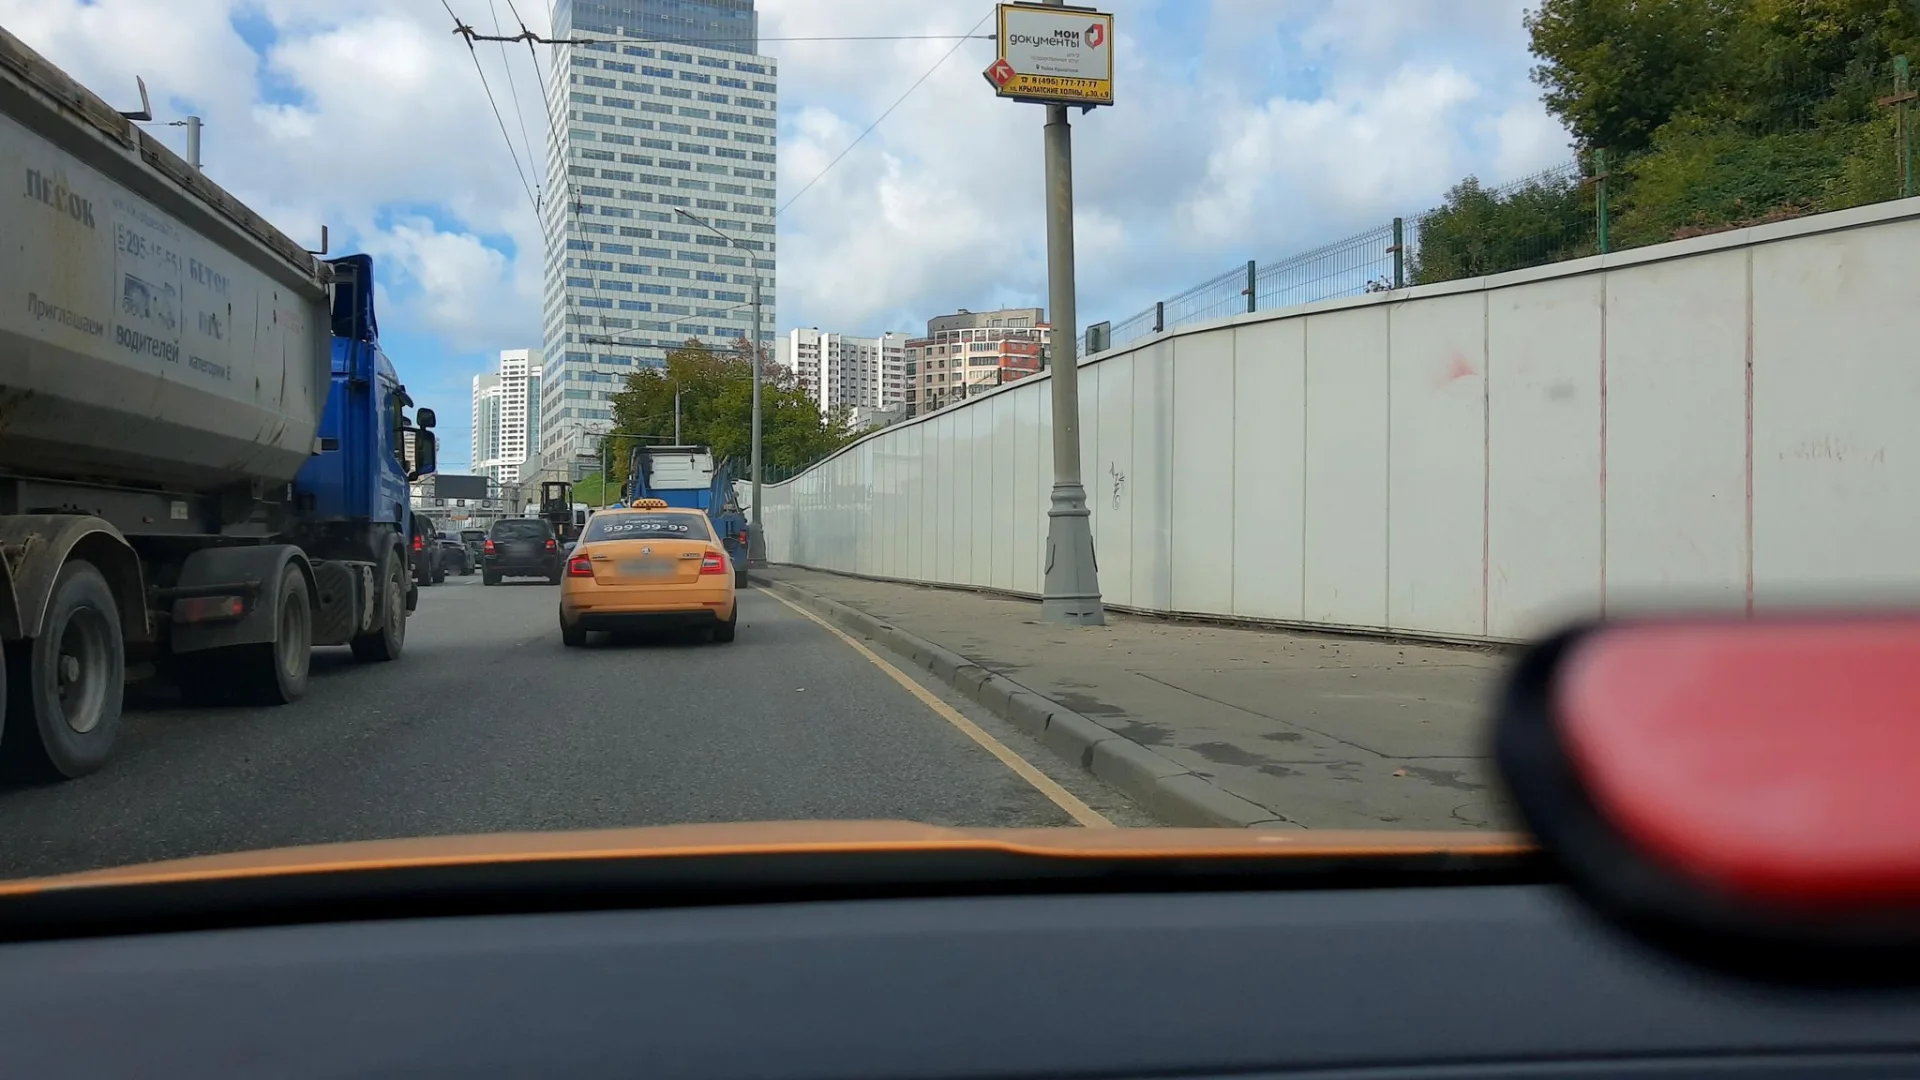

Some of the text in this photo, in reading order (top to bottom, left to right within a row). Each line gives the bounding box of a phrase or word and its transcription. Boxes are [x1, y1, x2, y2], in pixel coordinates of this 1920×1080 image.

[1009, 34, 1080, 48] документы
[1038, 77, 1059, 85] (495)
[1060, 79, 1098, 88] 777-77-77
[1018, 85, 1059, 94] КРЫЛАТСКИЕ
[26, 167, 95, 229] ПЕСОК
[28, 292, 104, 337] Приглашаем
[116, 324, 179, 364] водителей
[603, 523, 688, 533] 999-99-99
